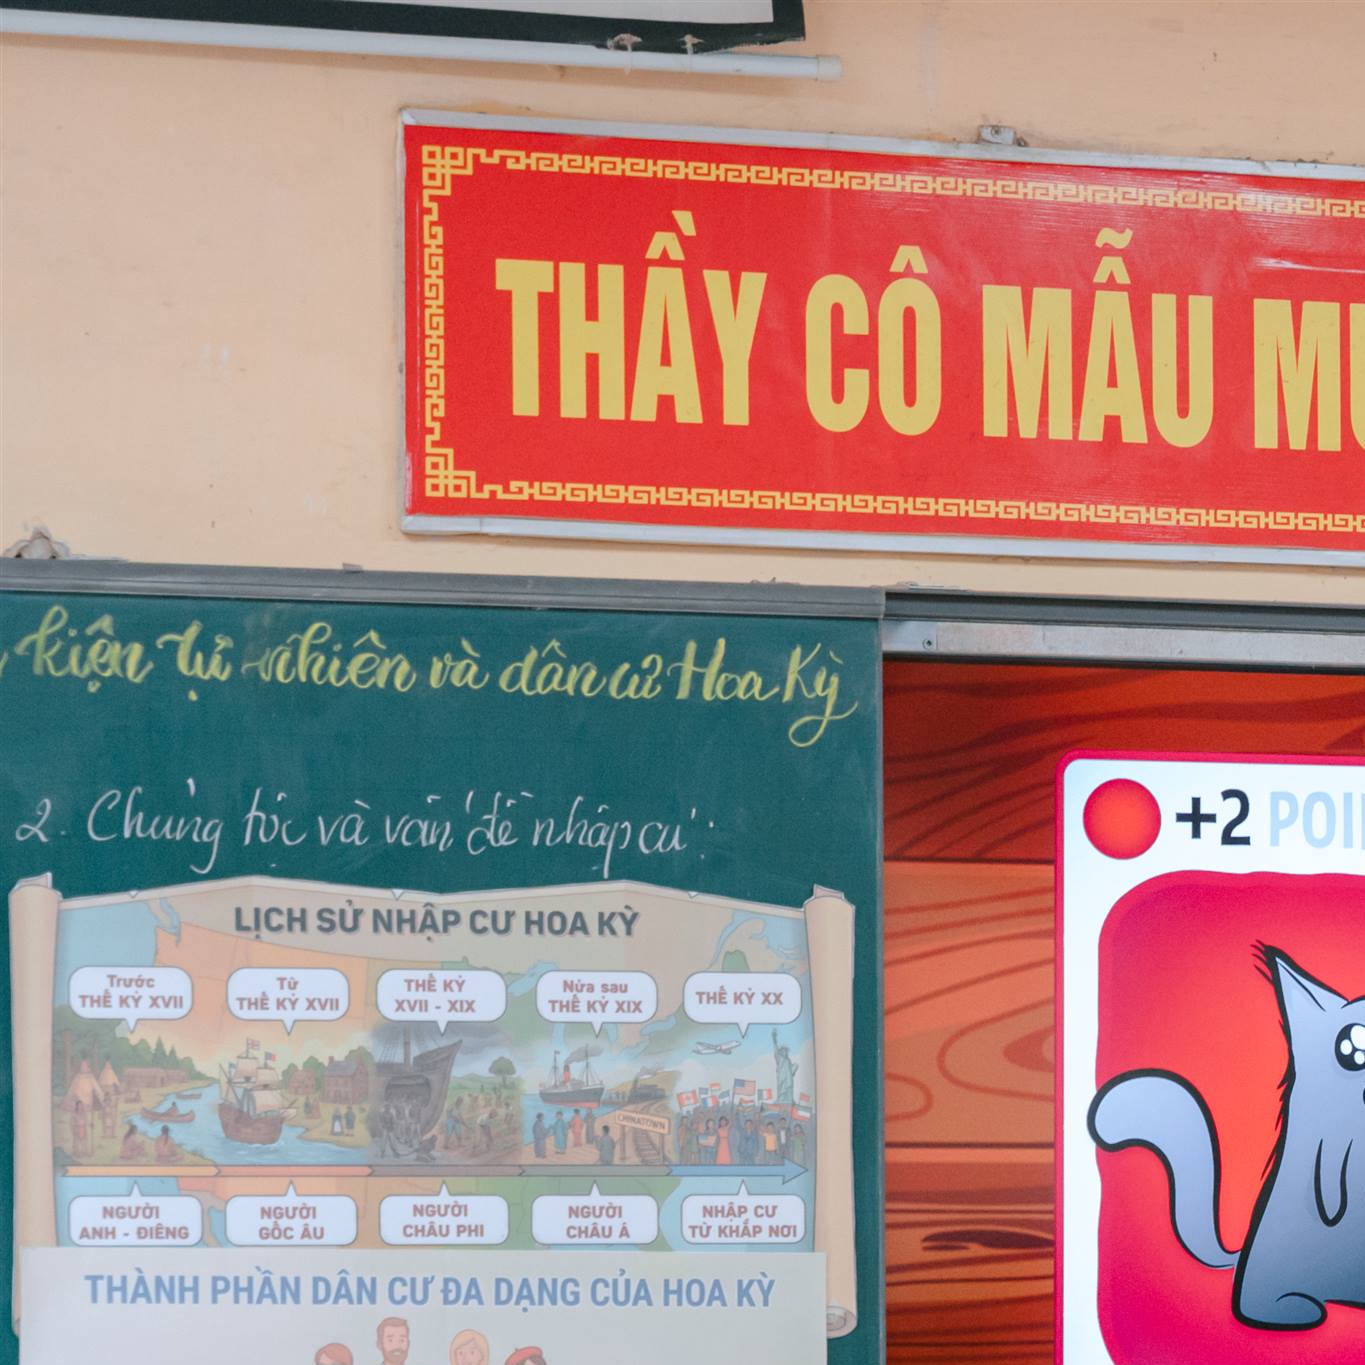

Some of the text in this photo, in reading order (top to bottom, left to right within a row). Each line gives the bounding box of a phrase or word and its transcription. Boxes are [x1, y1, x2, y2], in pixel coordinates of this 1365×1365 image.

[494, 210, 767, 426] THẦY
[805, 244, 942, 436] CÔ
[980, 227, 1213, 447] MẪU
[429, 638, 490, 689] và
[499, 639, 604, 697] dân
[667, 637, 780, 700] Hoa
[318, 799, 371, 846] và
[1175, 789, 1251, 846] +2
[234, 899, 640, 943] LỊCH SỬ NHẬP CƯ HOA KỲ
[107, 974, 155, 990] Trước
[277, 976, 299, 991] Từ
[405, 973, 437, 992] THẾ
[563, 979, 629, 994] Nửa sau
[79, 989, 111, 1009] THẾ
[149, 995, 184, 1010] XVII
[237, 992, 270, 1011] THẾ
[306, 998, 340, 1012] XVII
[395, 998, 476, 1014] XVII XIX
[549, 994, 580, 1013] THẾ
[615, 1001, 643, 1015] XIX
[696, 986, 727, 1006] THẾ
[761, 992, 784, 1007] XX
[102, 1203, 160, 1219] NGƯỜI
[260, 1203, 317, 1219] NGƯỜI
[412, 1202, 469, 1217] NGƯỜI
[568, 1203, 623, 1219] NGƯỜI
[702, 1203, 778, 1222] NHẬP CƯ
[79, 1222, 190, 1240] ANH ĐIÊNG
[259, 1222, 325, 1240] GỐC ÂU
[402, 1220, 484, 1237] CHÂU PHI
[566, 1221, 631, 1240] CHÂU Á
[689, 1221, 797, 1240] TỪ KHẮP NƠI
[85, 1267, 776, 1312] THÀNH PHẦN DÂN CƯ ĐA DẠNG CỦA HOA KỲ
